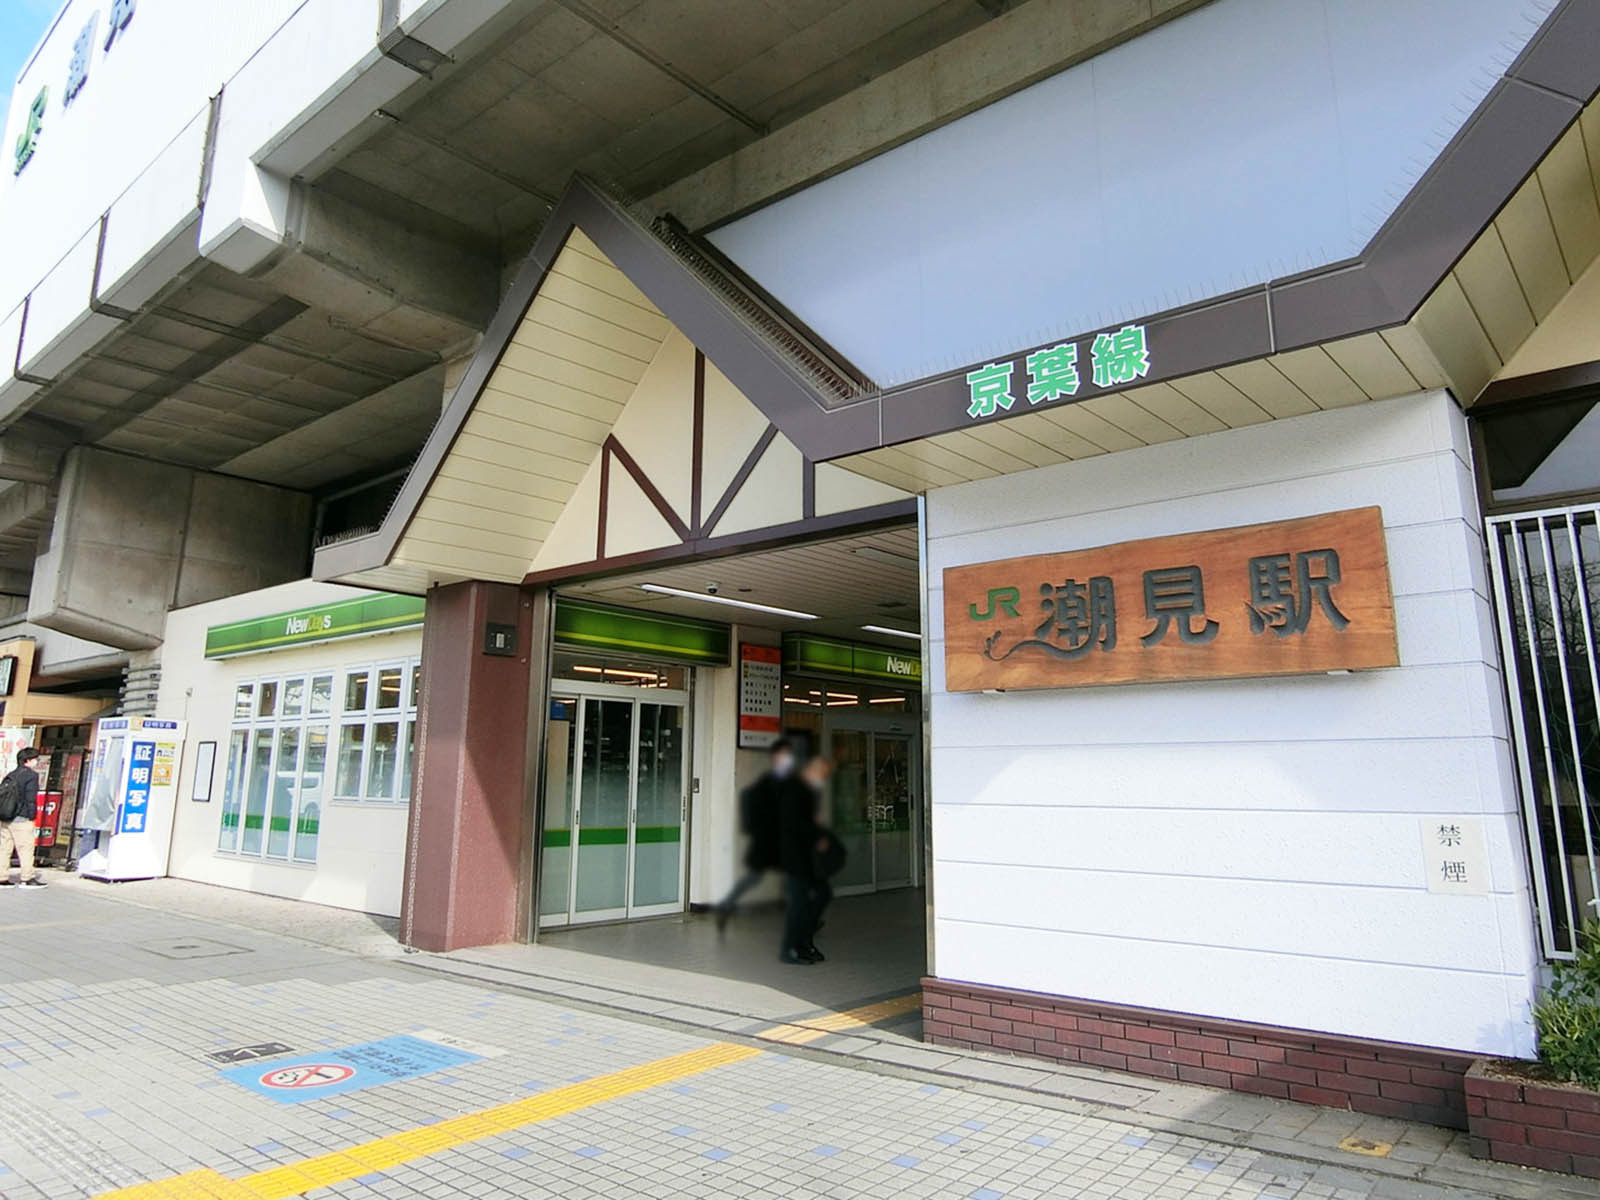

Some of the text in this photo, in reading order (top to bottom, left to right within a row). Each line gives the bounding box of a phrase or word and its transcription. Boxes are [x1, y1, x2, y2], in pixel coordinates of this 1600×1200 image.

[965, 324, 1152, 419] 京葉線
[969, 548, 1351, 661] JR 潮見駅
[125, 744, 152, 830] 証明写真
[1435, 823, 1469, 884] 禁煙
